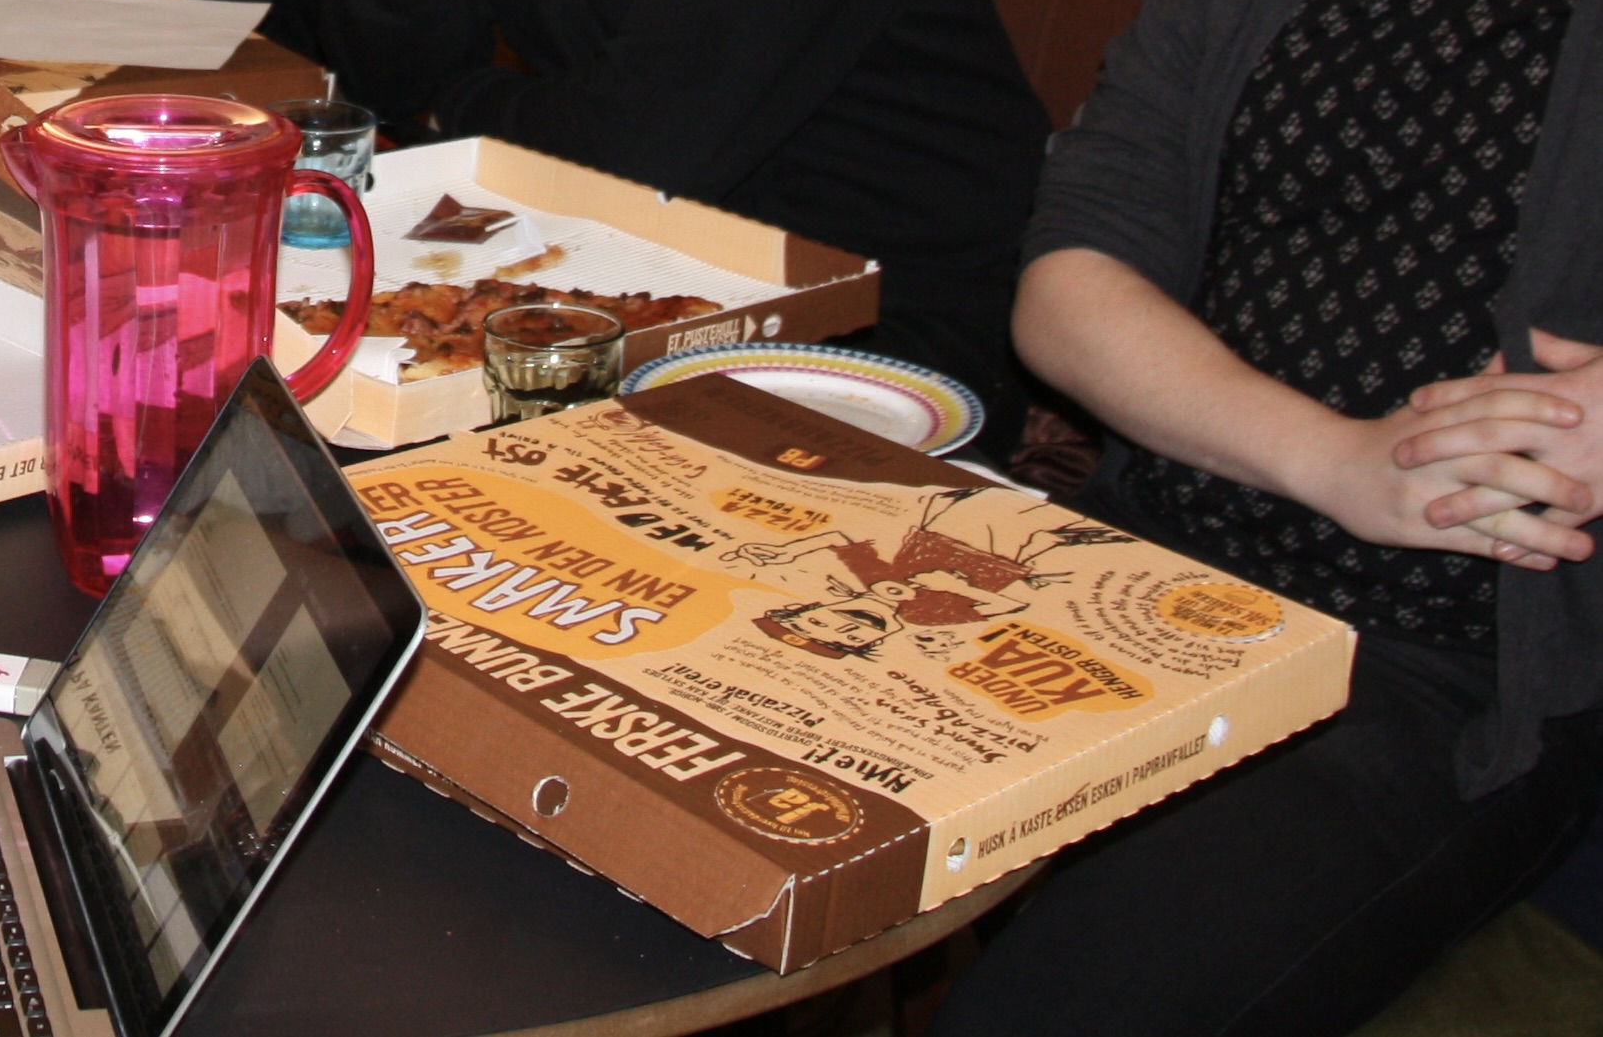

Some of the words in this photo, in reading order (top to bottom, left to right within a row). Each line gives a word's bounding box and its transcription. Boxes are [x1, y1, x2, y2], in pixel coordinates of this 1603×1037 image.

[10, 457, 36, 479] DET
[773, 446, 824, 469] PB
[413, 477, 548, 545] KOSTER
[721, 499, 813, 532] PIZZA
[610, 512, 716, 552] MED
[371, 509, 666, 647] SMAKER
[521, 539, 616, 579] DEN
[600, 568, 695, 608] ENN
[943, 660, 1052, 714] UNDER
[977, 638, 1108, 705] KUA
[1073, 658, 1144, 698] HENGER
[657, 662, 829, 728] Pizzabakeren!
[536, 682, 748, 781] FERSKE
[763, 786, 832, 825] Ja
[978, 830, 1007, 860] HUSK
[1009, 820, 1017, 845] Å
[1020, 807, 1054, 839] KASTE
[1091, 775, 1124, 806] ESKEN
[1132, 734, 1207, 784] PAPIRAVFALLET
